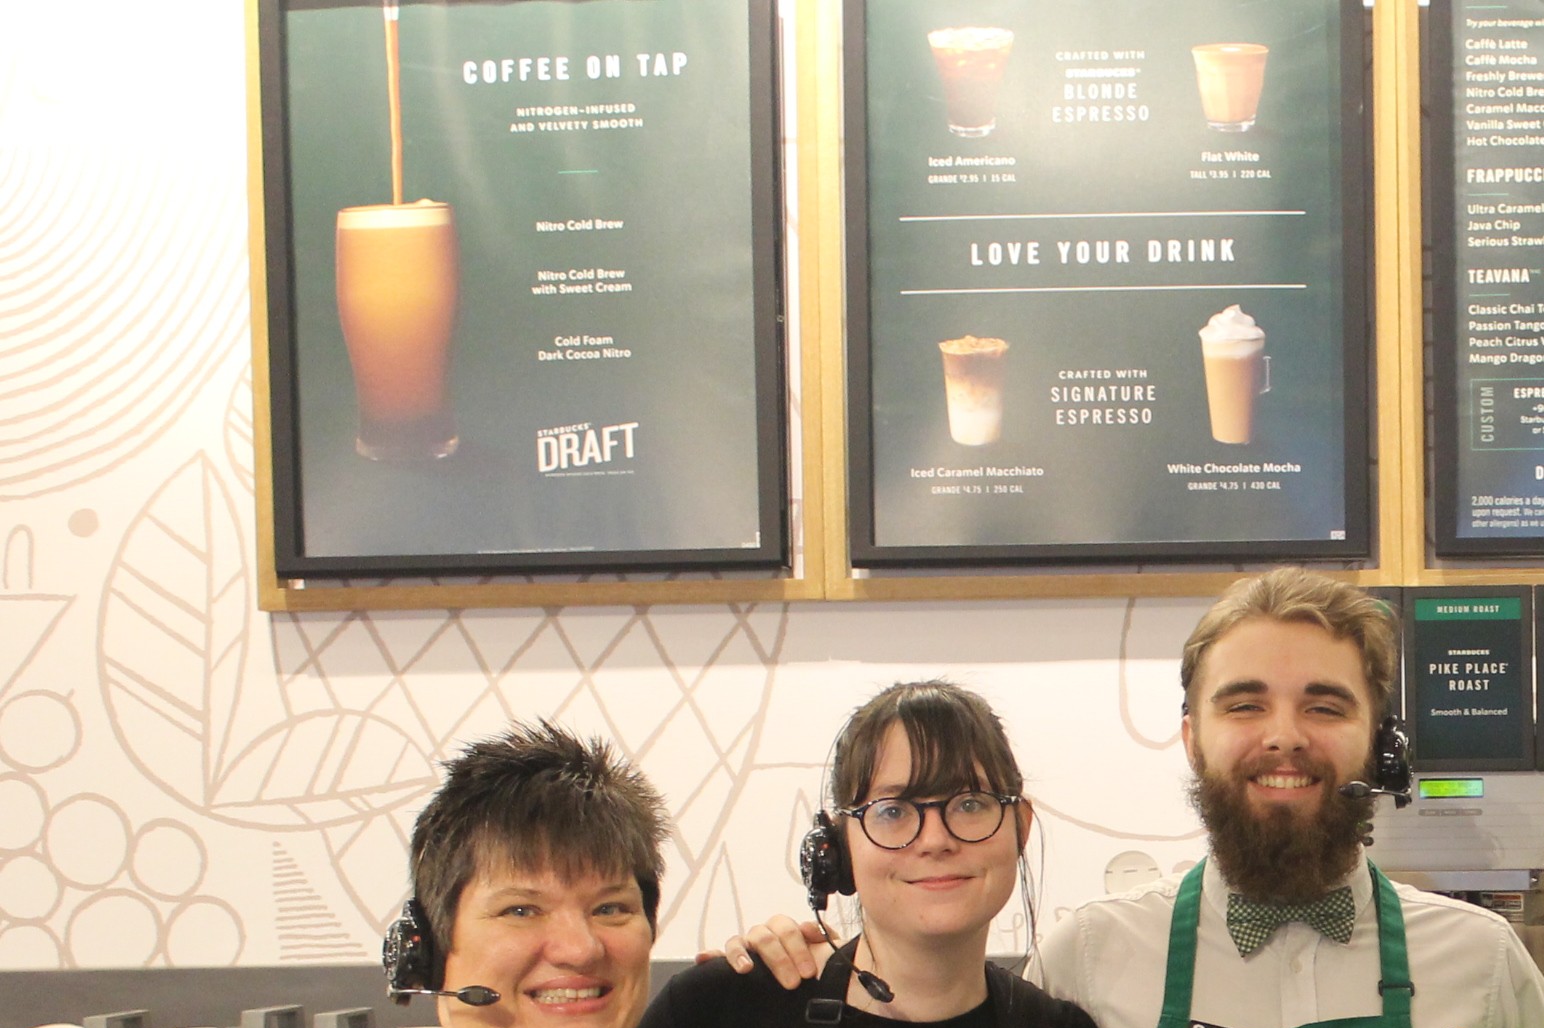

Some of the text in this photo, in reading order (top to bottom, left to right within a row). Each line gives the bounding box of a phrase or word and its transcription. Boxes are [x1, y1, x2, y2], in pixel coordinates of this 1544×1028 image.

[1465, 38, 1529, 50] Caffè Latte
[462, 52, 688, 85] COFFEE ON TAP
[1063, 82, 1137, 101] BLONDE
[516, 103, 636, 117] NITROGEN-INFUSED
[1051, 104, 1149, 124] ESPRESSO
[509, 118, 644, 133] AND VELVETY SMOOTH
[1466, 136, 1488, 147] Hot
[928, 155, 1017, 167] Iced Americano
[1467, 220, 1493, 231] Java
[1493, 219, 1521, 231] Chip
[971, 238, 1235, 266] LOVE YOUR DRINK
[1467, 268, 1530, 284] TEAVANA
[554, 335, 614, 347] Cold Foam
[538, 348, 632, 361] Dark Cocoa Nitro
[1050, 385, 1156, 403] SIGNATURE
[1055, 408, 1152, 425] ESPRESSO
[537, 421, 639, 473] DRAFT
[1167, 462, 1301, 474] White Chocolate Mocha
[1436, 605, 1500, 614] MEDIUM ROAST
[1429, 662, 1508, 675] PIKE PLACE
[1448, 679, 1490, 691] ROAST
[1430, 707, 1508, 717] Smooth & Balanced
